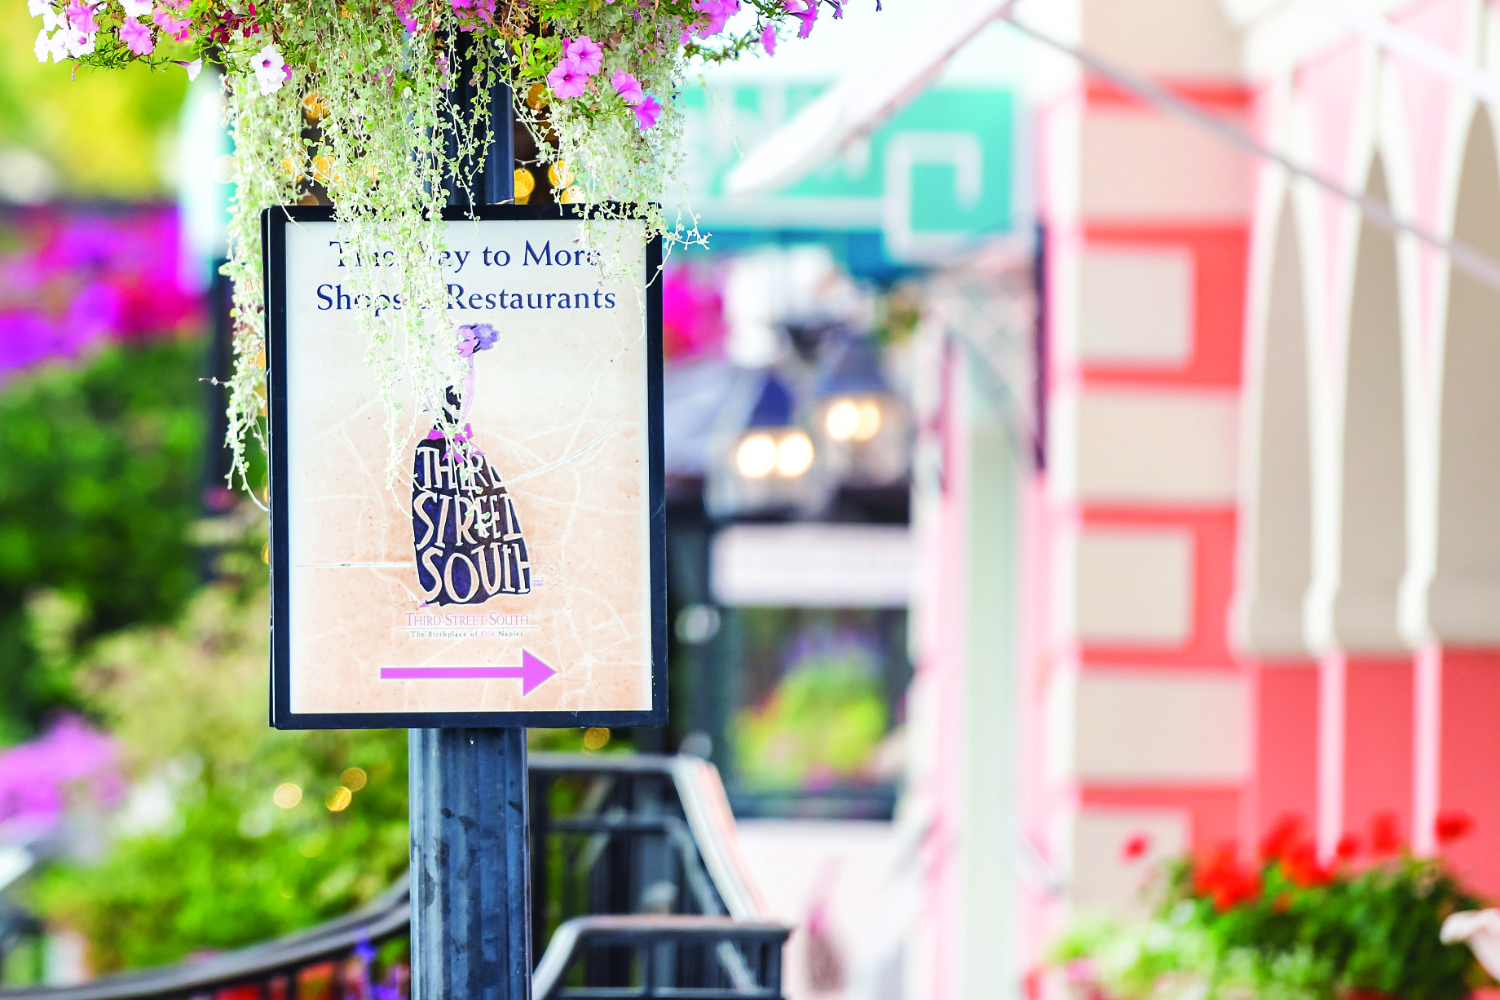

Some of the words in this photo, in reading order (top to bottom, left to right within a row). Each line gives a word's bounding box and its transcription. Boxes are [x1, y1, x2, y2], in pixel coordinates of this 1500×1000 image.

[482, 245, 511, 267] to
[316, 283, 402, 317] Shops
[446, 282, 616, 310] Restaurants
[413, 492, 523, 550] STREET
[421, 542, 531, 602] SOUTH
[404, 612, 442, 627] THIRD
[445, 611, 486, 626] STREET
[489, 611, 529, 626] SOUTH
[411, 630, 425, 638] The
